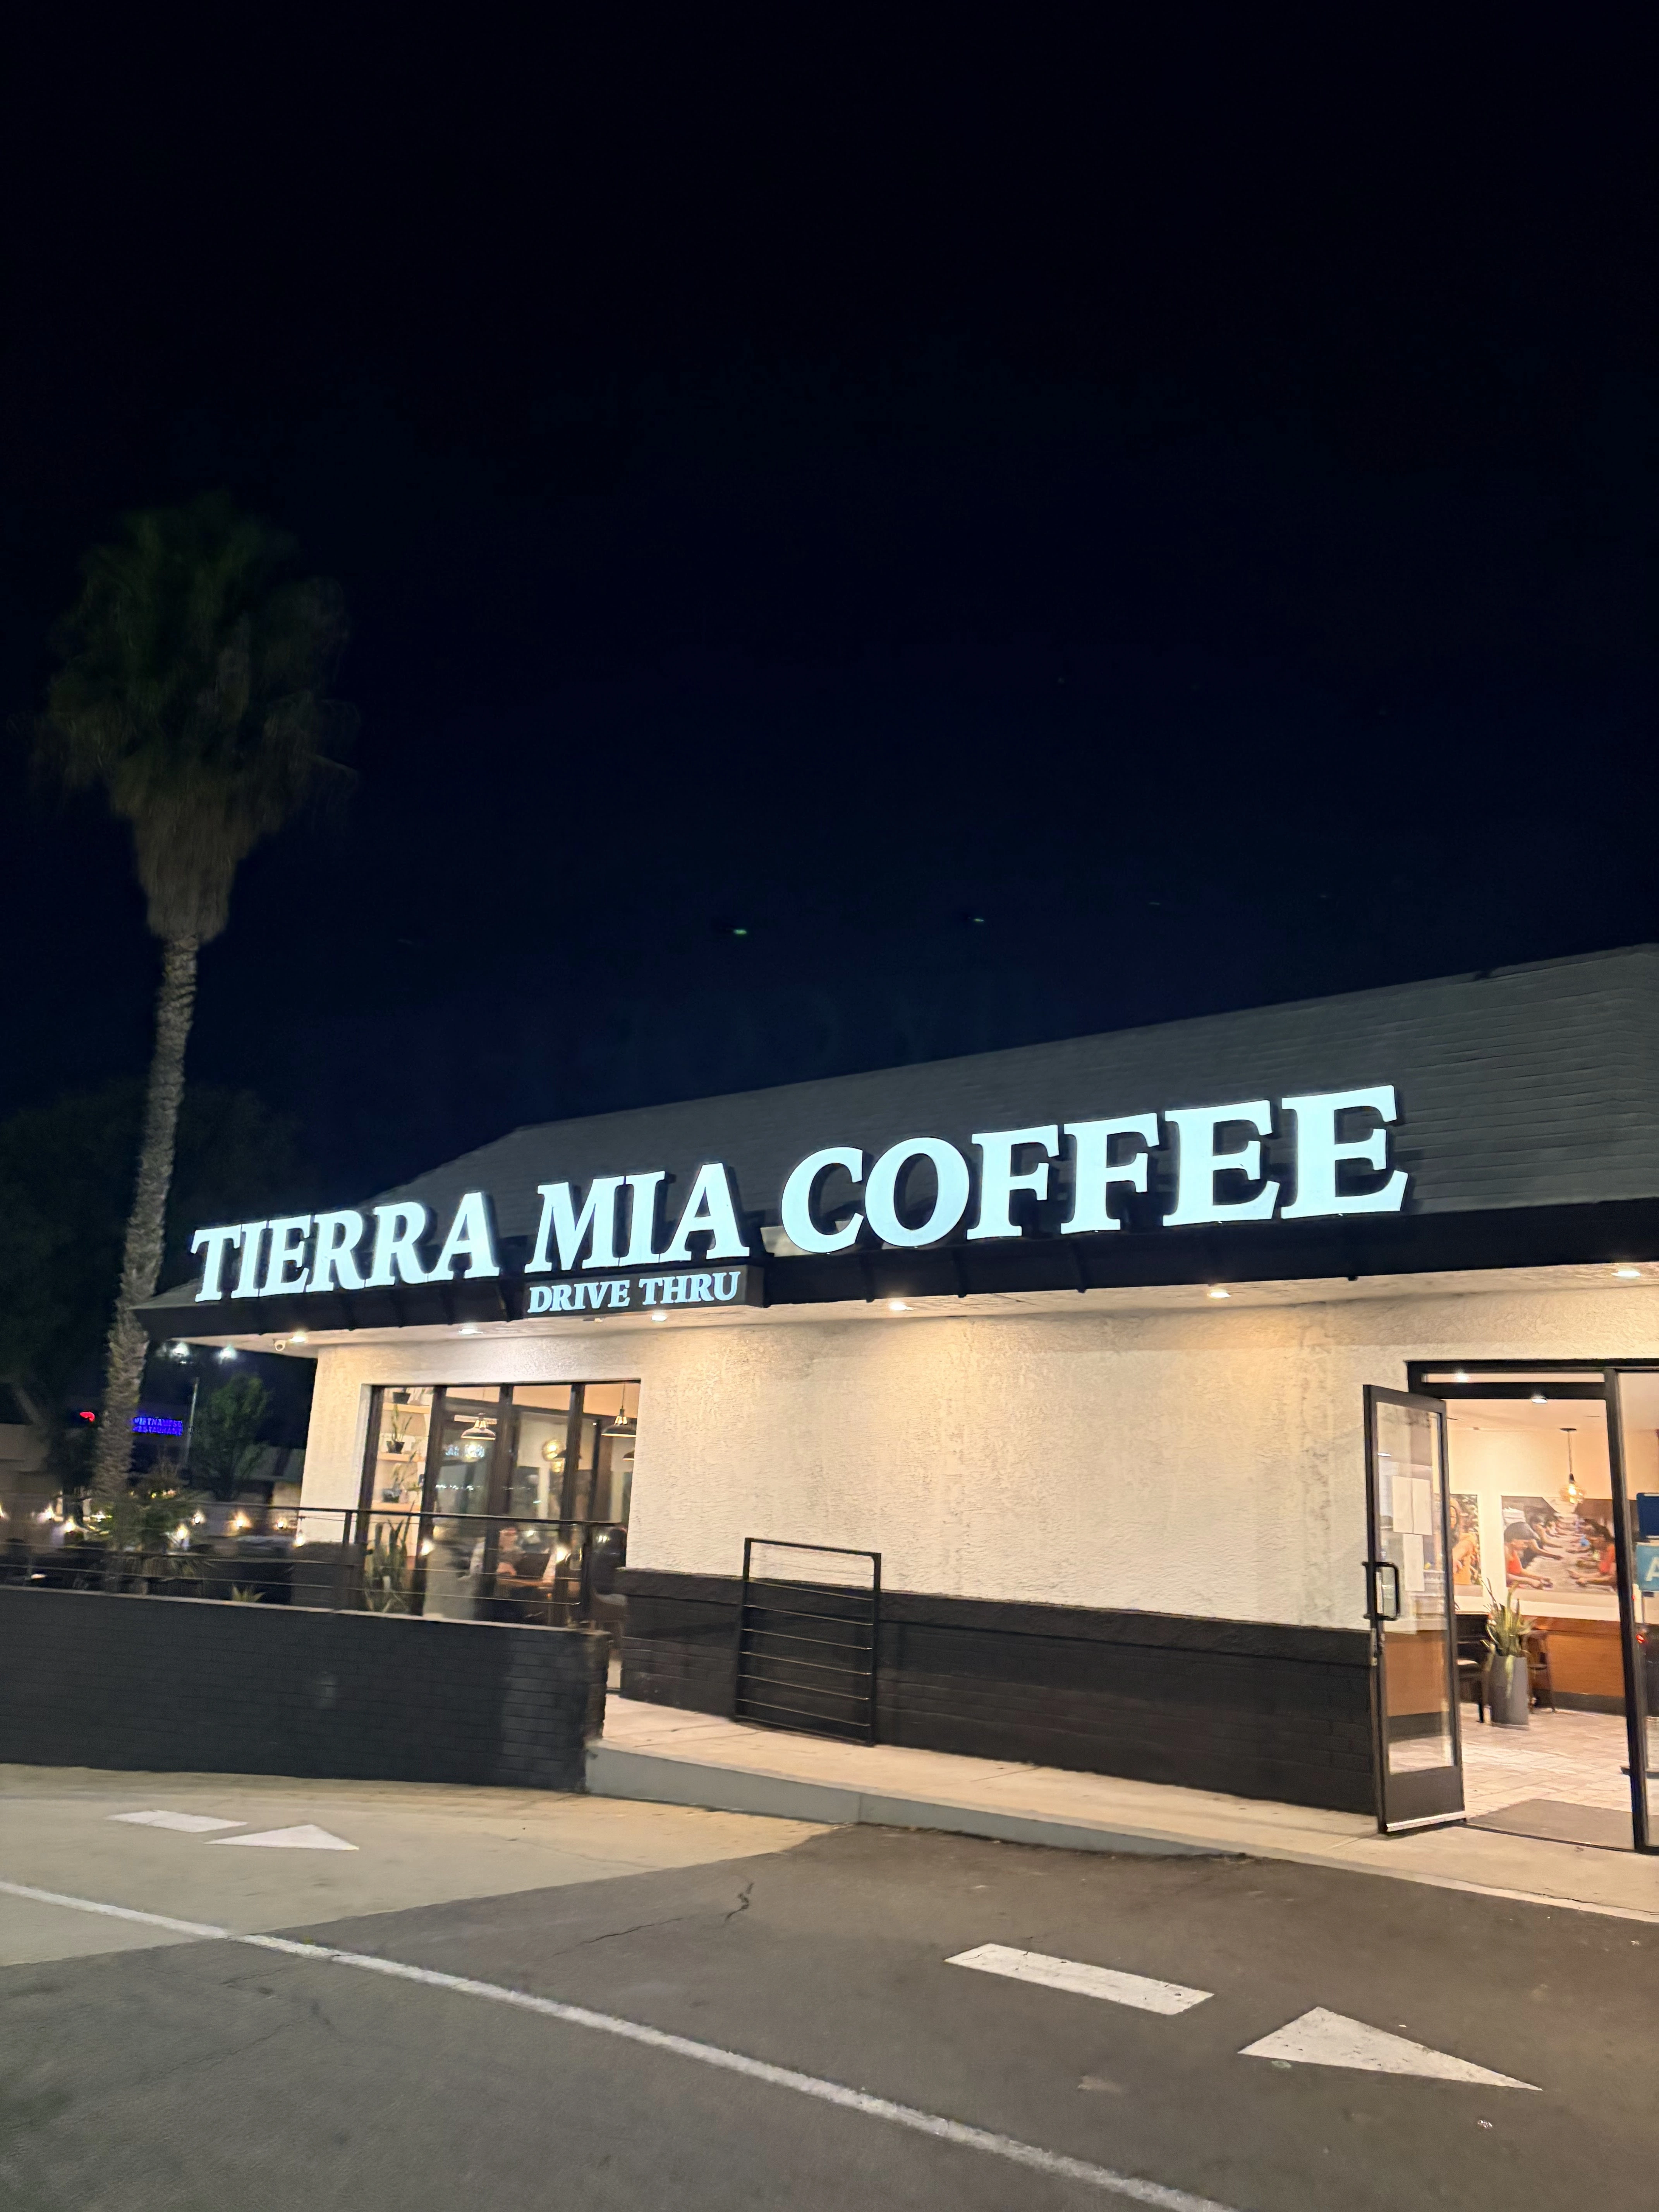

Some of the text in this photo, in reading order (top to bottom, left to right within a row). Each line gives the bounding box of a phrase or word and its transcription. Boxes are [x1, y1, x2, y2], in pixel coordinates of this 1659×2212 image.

[191, 1085, 1408, 1302] TIERRA MIA COFFEE
[527, 1271, 741, 1313] DRIVE THRU
